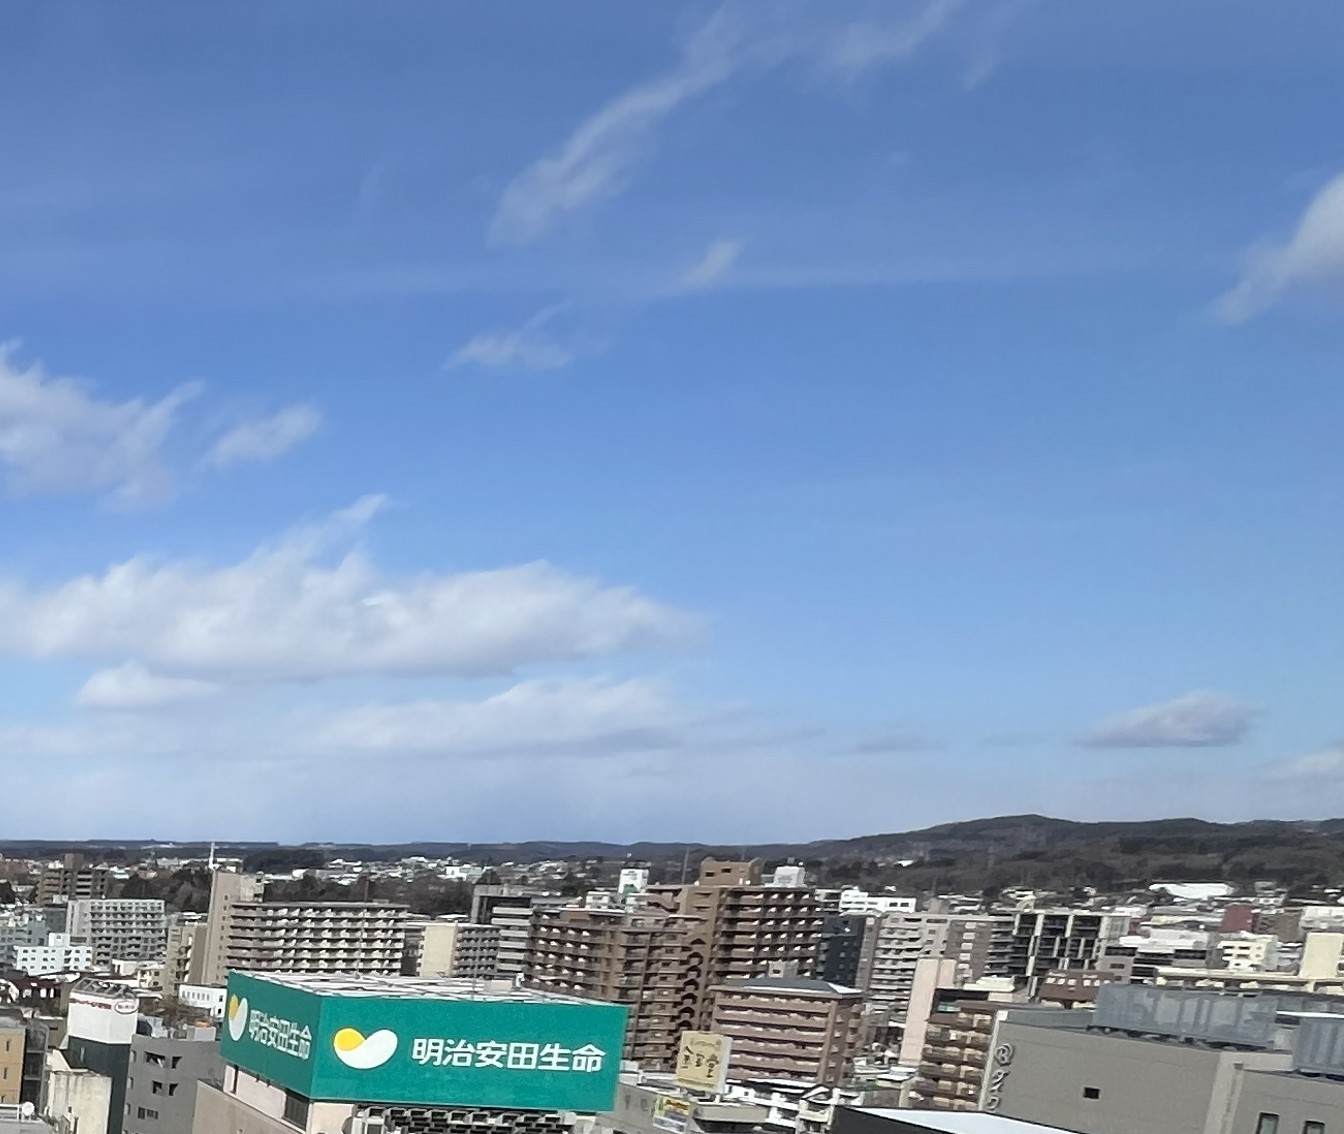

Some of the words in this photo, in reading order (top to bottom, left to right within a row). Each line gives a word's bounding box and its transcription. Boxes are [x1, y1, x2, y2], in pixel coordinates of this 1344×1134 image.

[248, 1008, 313, 1061] 明治安田生命
[411, 1037, 607, 1074] 明治安田生命
